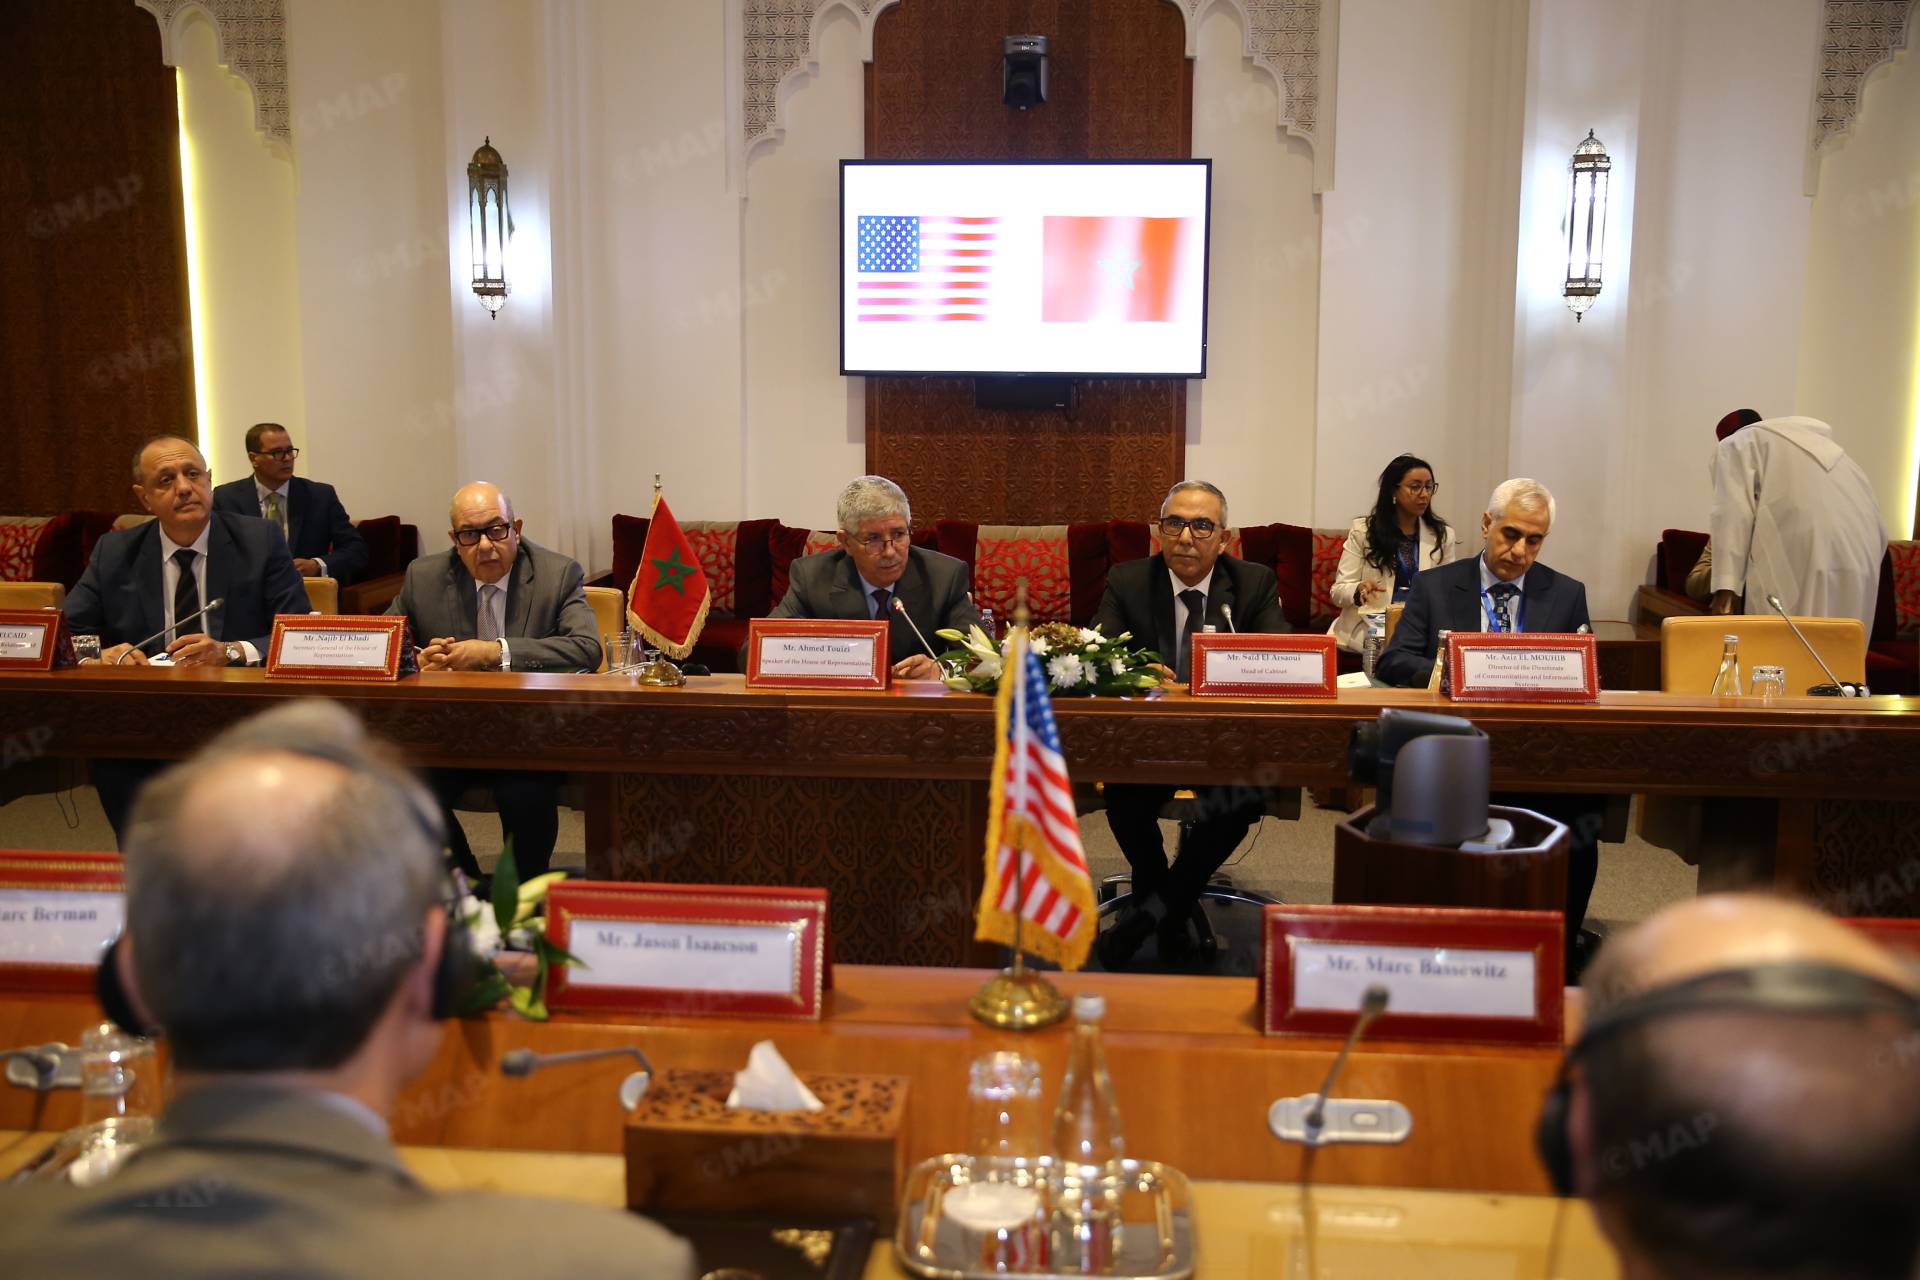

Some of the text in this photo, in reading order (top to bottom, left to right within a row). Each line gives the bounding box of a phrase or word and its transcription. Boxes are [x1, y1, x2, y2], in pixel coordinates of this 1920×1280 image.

[799, 644, 824, 652] Ahmed
[1486, 653, 1499, 661] Mr.
[1531, 654, 1566, 662] MOUHIB
[33, 906, 97, 921] Berman
[597, 931, 627, 948] Mr.
[632, 932, 680, 949] Jason
[1326, 954, 1508, 979] Mr. Marc Bassewitz
